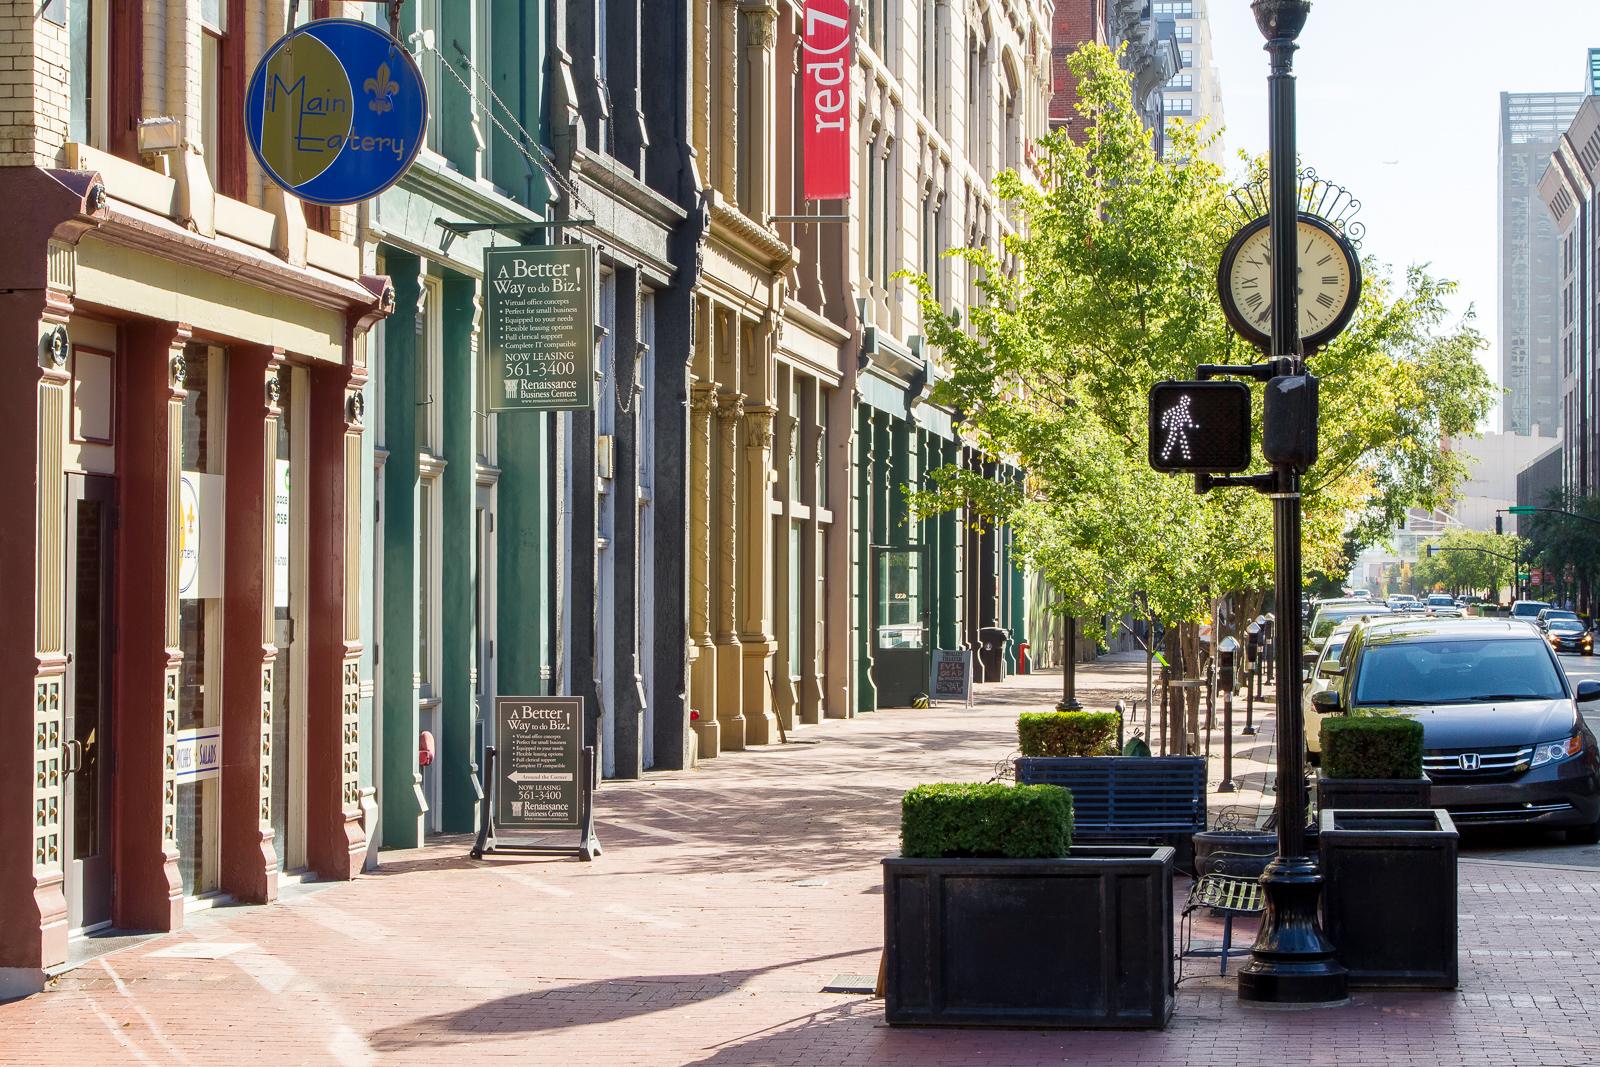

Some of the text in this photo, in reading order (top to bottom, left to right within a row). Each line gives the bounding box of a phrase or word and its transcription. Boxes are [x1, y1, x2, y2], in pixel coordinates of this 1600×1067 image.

[271, 73, 346, 113] Main
[294, 112, 405, 161] Eatery
[497, 259, 571, 279] A Better
[493, 280, 526, 298] Way
[538, 282, 550, 293] do
[504, 316, 534, 324] Equipped
[505, 342, 534, 350] Complete
[544, 340, 576, 349] compatible
[504, 352, 574, 362] NOW LEASING
[506, 360, 575, 378] 561-3400
[520, 378, 577, 390] Renaissance
[520, 389, 577, 399] Business Centers
[510, 705, 564, 720] A Better
[506, 720, 530, 733] Way
[200, 744, 216, 766] SALADS
[518, 790, 562, 800] 561-3400
[524, 800, 568, 810] Renaissance
